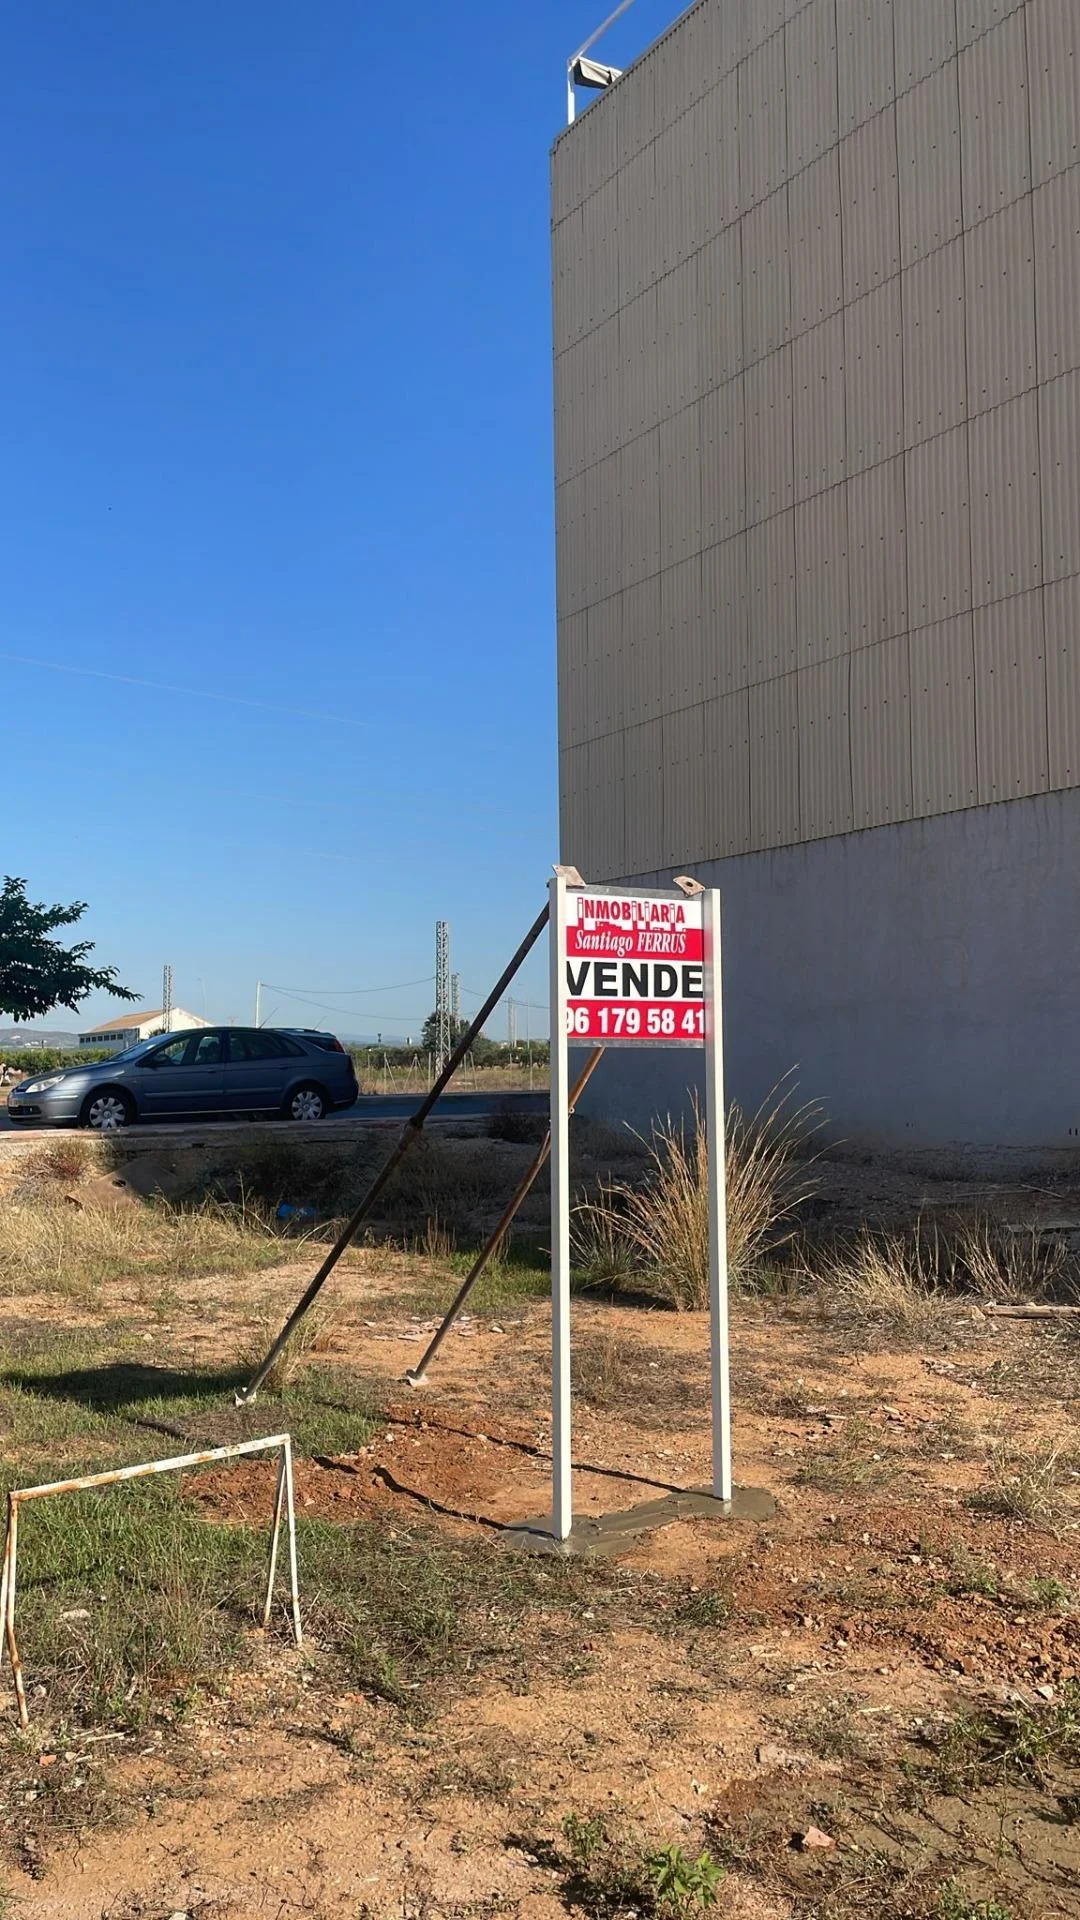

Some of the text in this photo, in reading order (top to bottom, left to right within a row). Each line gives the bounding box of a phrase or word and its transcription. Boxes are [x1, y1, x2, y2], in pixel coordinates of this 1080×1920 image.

[575, 929, 687, 957] Santiago FERRUS
[566, 961, 704, 998] VENDE
[597, 1007, 640, 1034] 179
[647, 1008, 675, 1035] 58
[681, 1008, 704, 1034] 41
